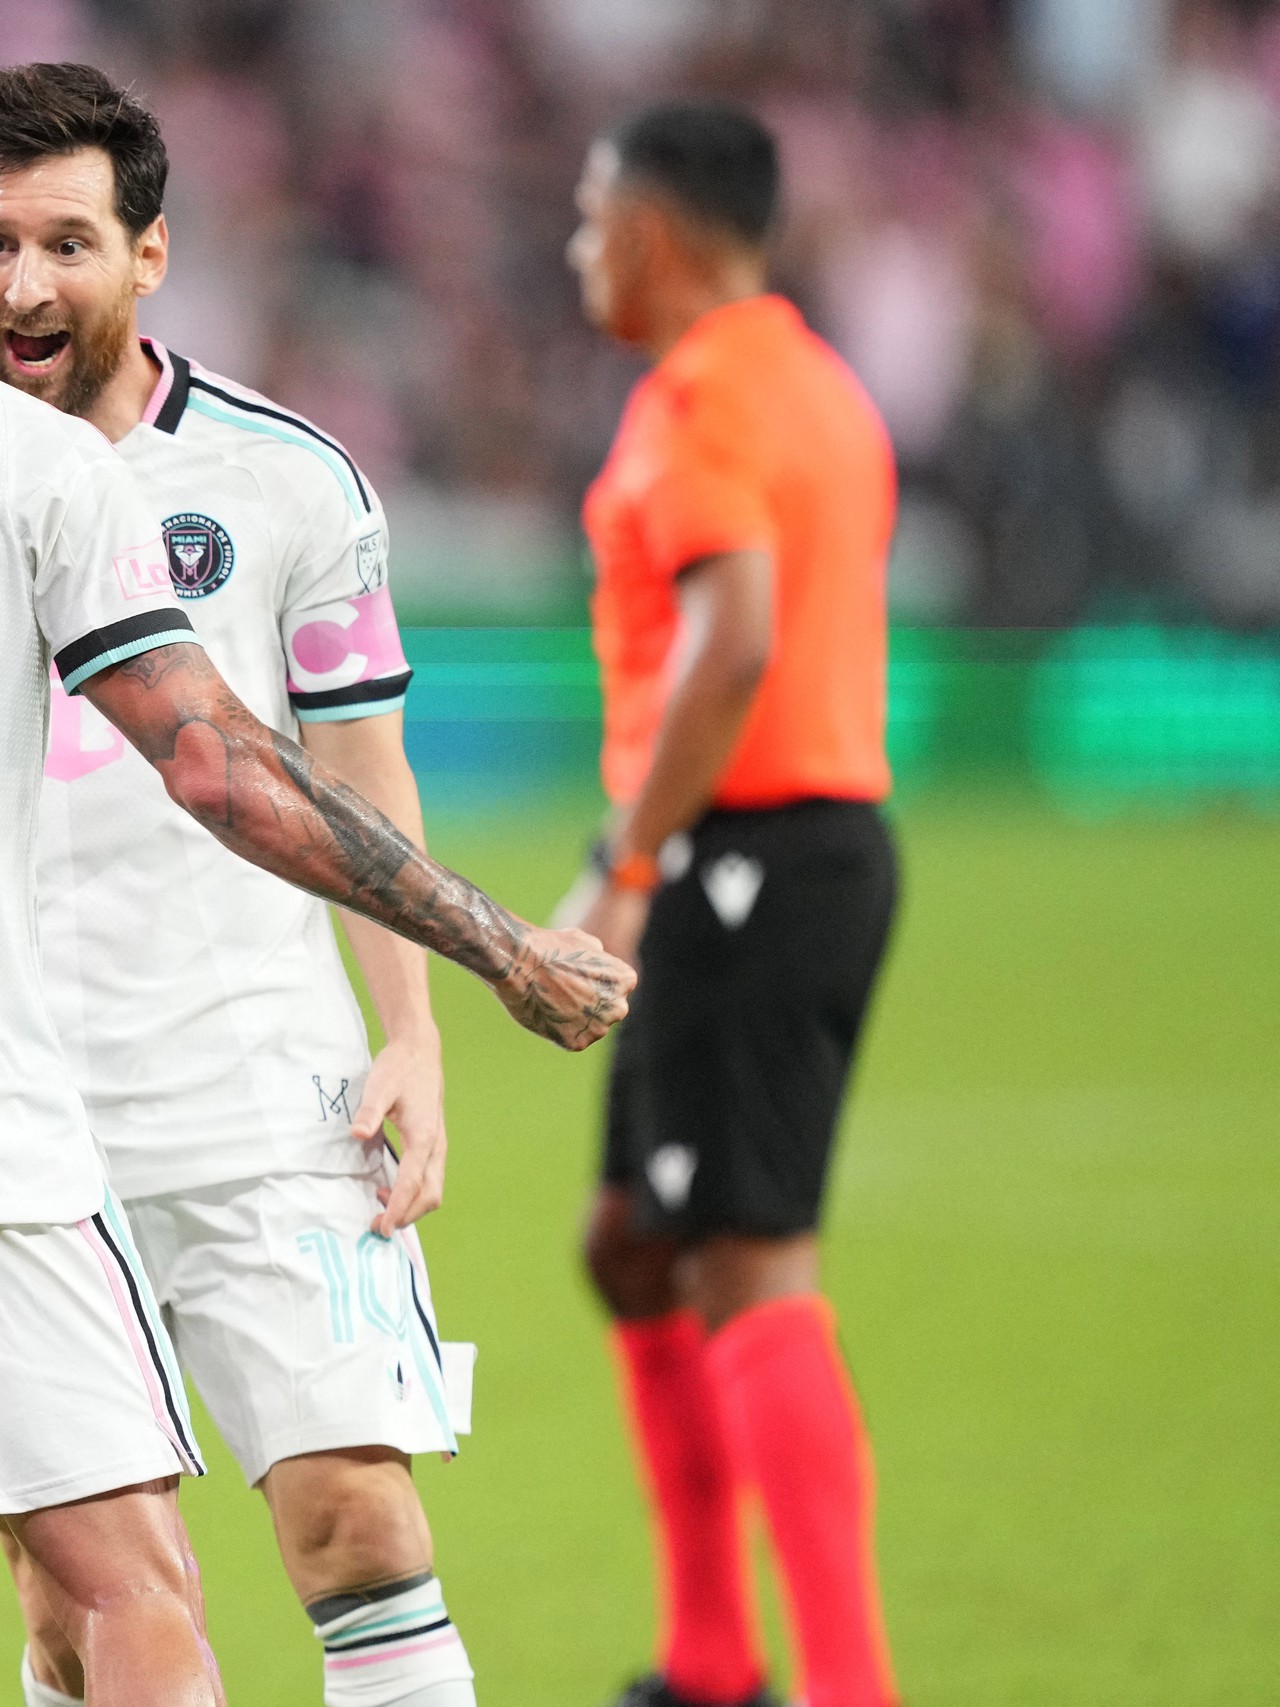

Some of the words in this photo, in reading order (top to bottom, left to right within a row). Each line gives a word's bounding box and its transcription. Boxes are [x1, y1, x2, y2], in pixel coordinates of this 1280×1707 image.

[171, 535, 207, 544] MIAMI
[359, 538, 378, 554] MLS
[281, 601, 369, 692] C
[296, 1229, 408, 1343] 10
